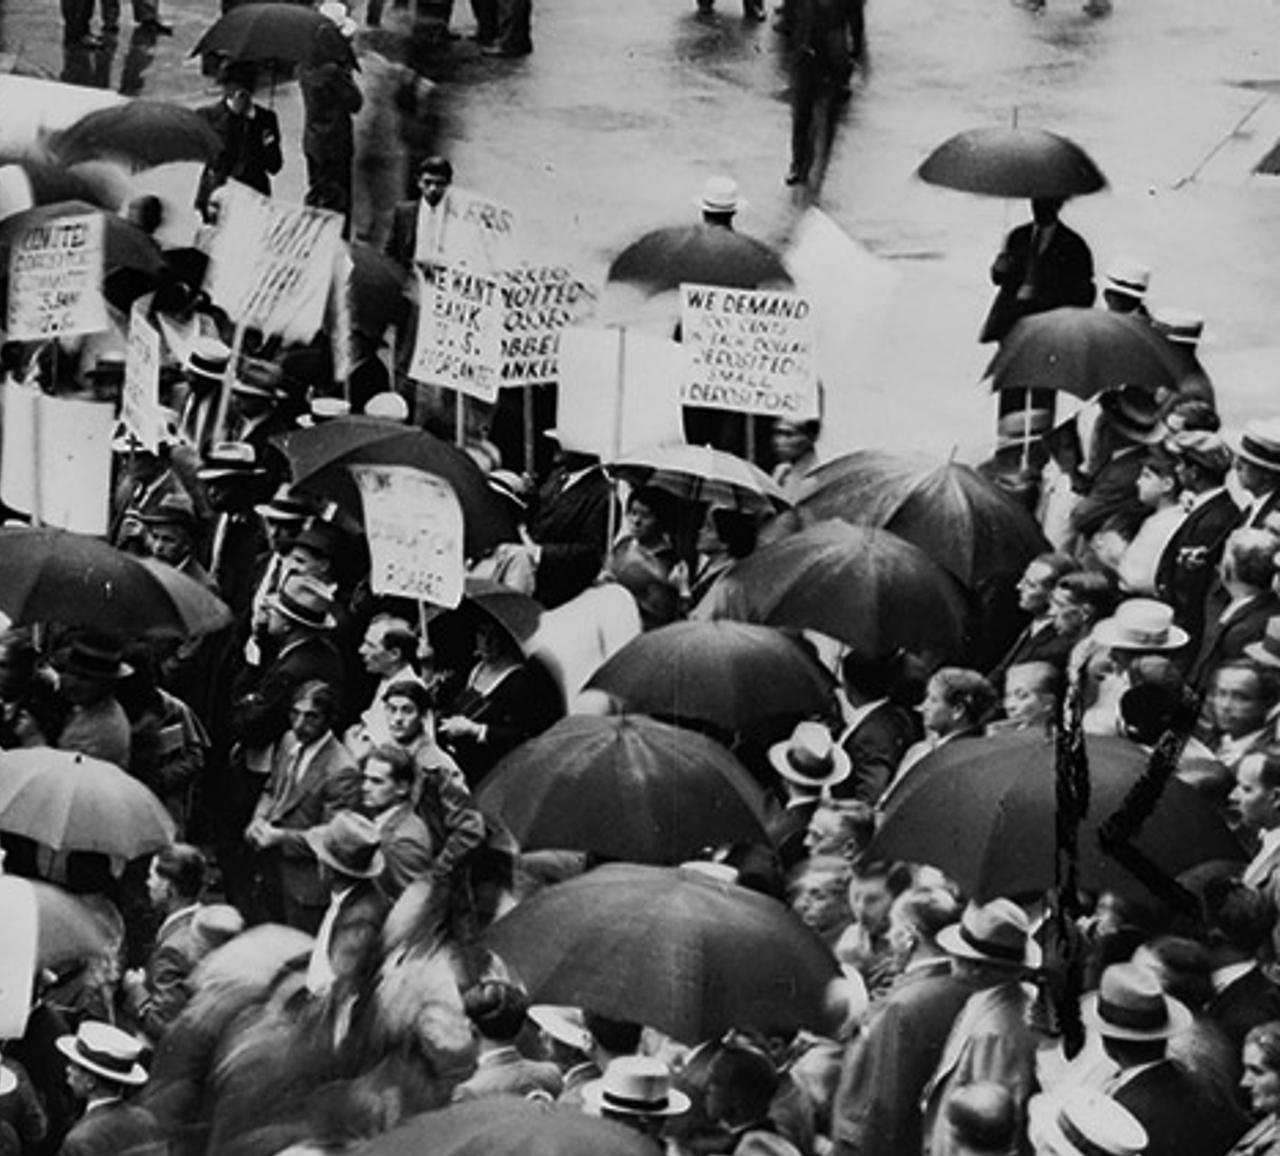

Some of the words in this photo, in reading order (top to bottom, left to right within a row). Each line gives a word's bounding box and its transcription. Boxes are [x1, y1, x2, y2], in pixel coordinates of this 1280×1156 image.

[688, 291, 717, 311] WE
[723, 294, 811, 319] DEMAND
[707, 371, 775, 390] SMALL
